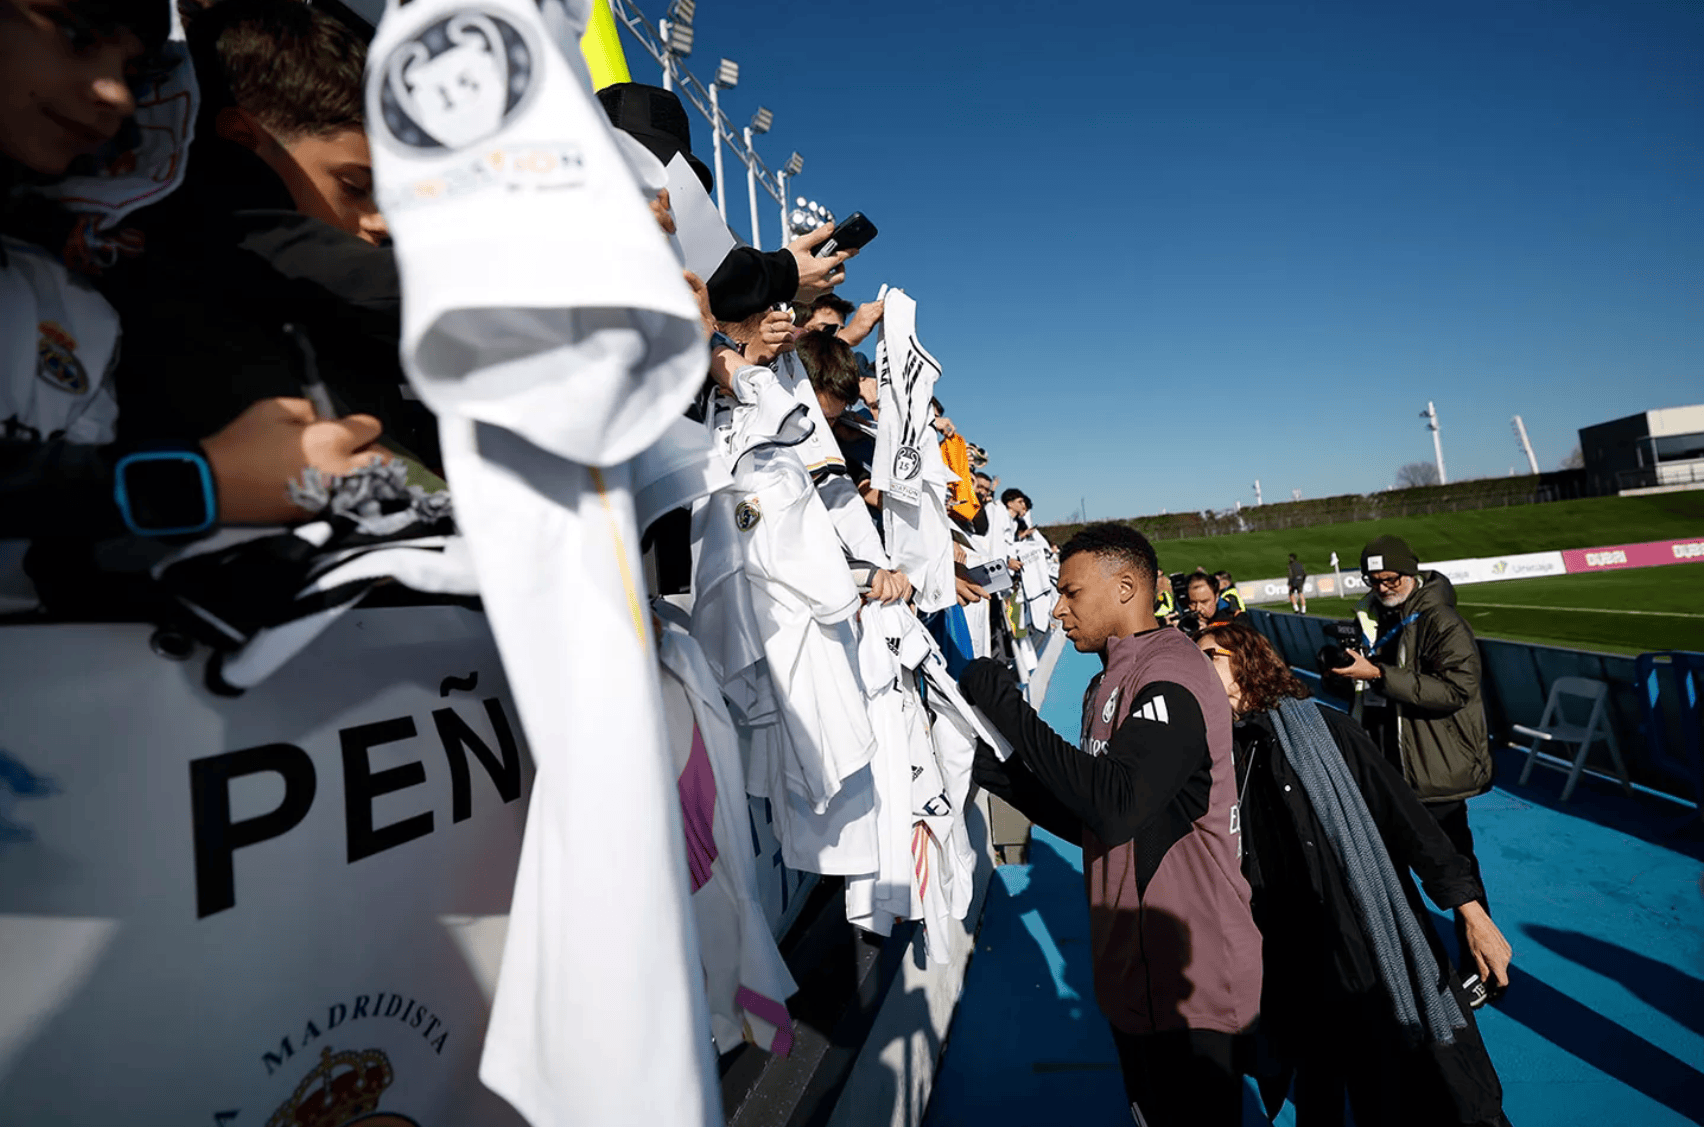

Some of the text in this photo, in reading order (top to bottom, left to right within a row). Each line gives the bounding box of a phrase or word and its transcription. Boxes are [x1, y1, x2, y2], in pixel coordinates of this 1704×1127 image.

[898, 460, 910, 471] 15
[189, 671, 521, 919] PEÑ
[261, 992, 449, 1077] MADRIDISTA
